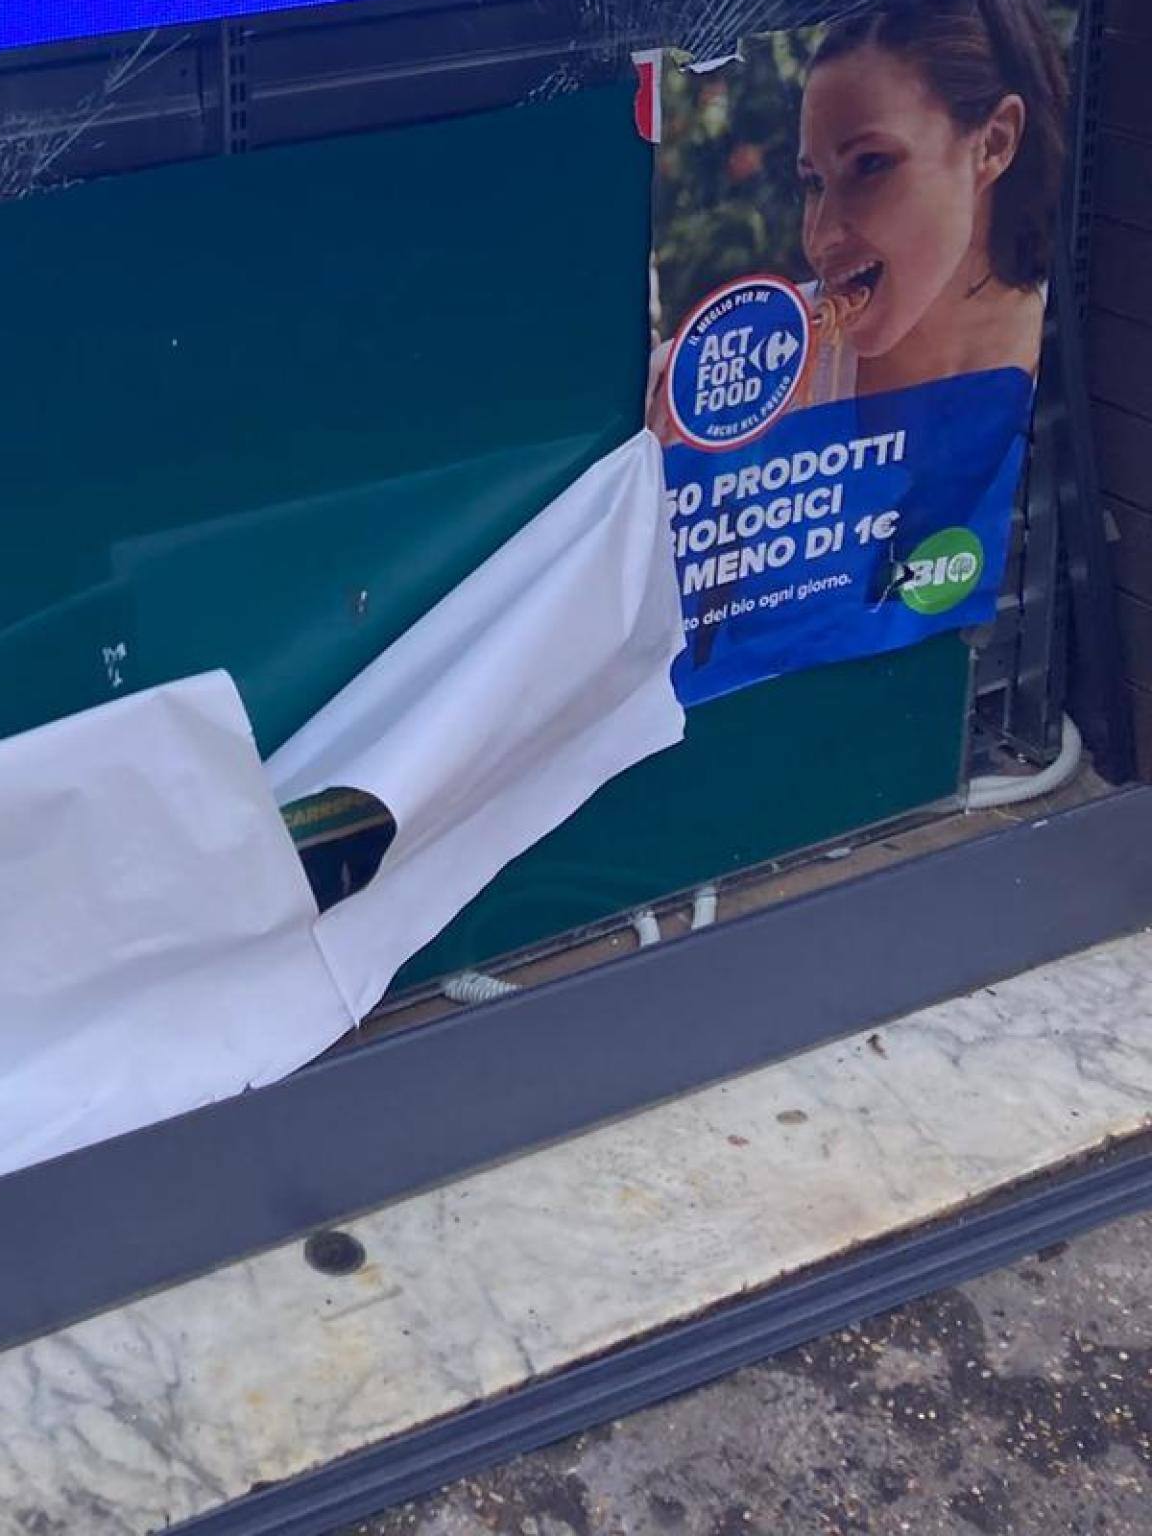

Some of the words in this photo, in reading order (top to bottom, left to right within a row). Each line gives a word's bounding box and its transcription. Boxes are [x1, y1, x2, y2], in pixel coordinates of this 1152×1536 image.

[700, 326, 753, 363] ACT
[698, 356, 746, 391] FOR
[695, 377, 762, 416] FOOD
[711, 430, 906, 507] PRODOTTI
[671, 483, 844, 558] IOLOGICI
[683, 536, 796, 595] MENO
[805, 522, 845, 560] DI
[854, 510, 900, 544] 1€
[703, 603, 729, 624] del
[731, 597, 755, 614] bio
[759, 584, 794, 609] ogni
